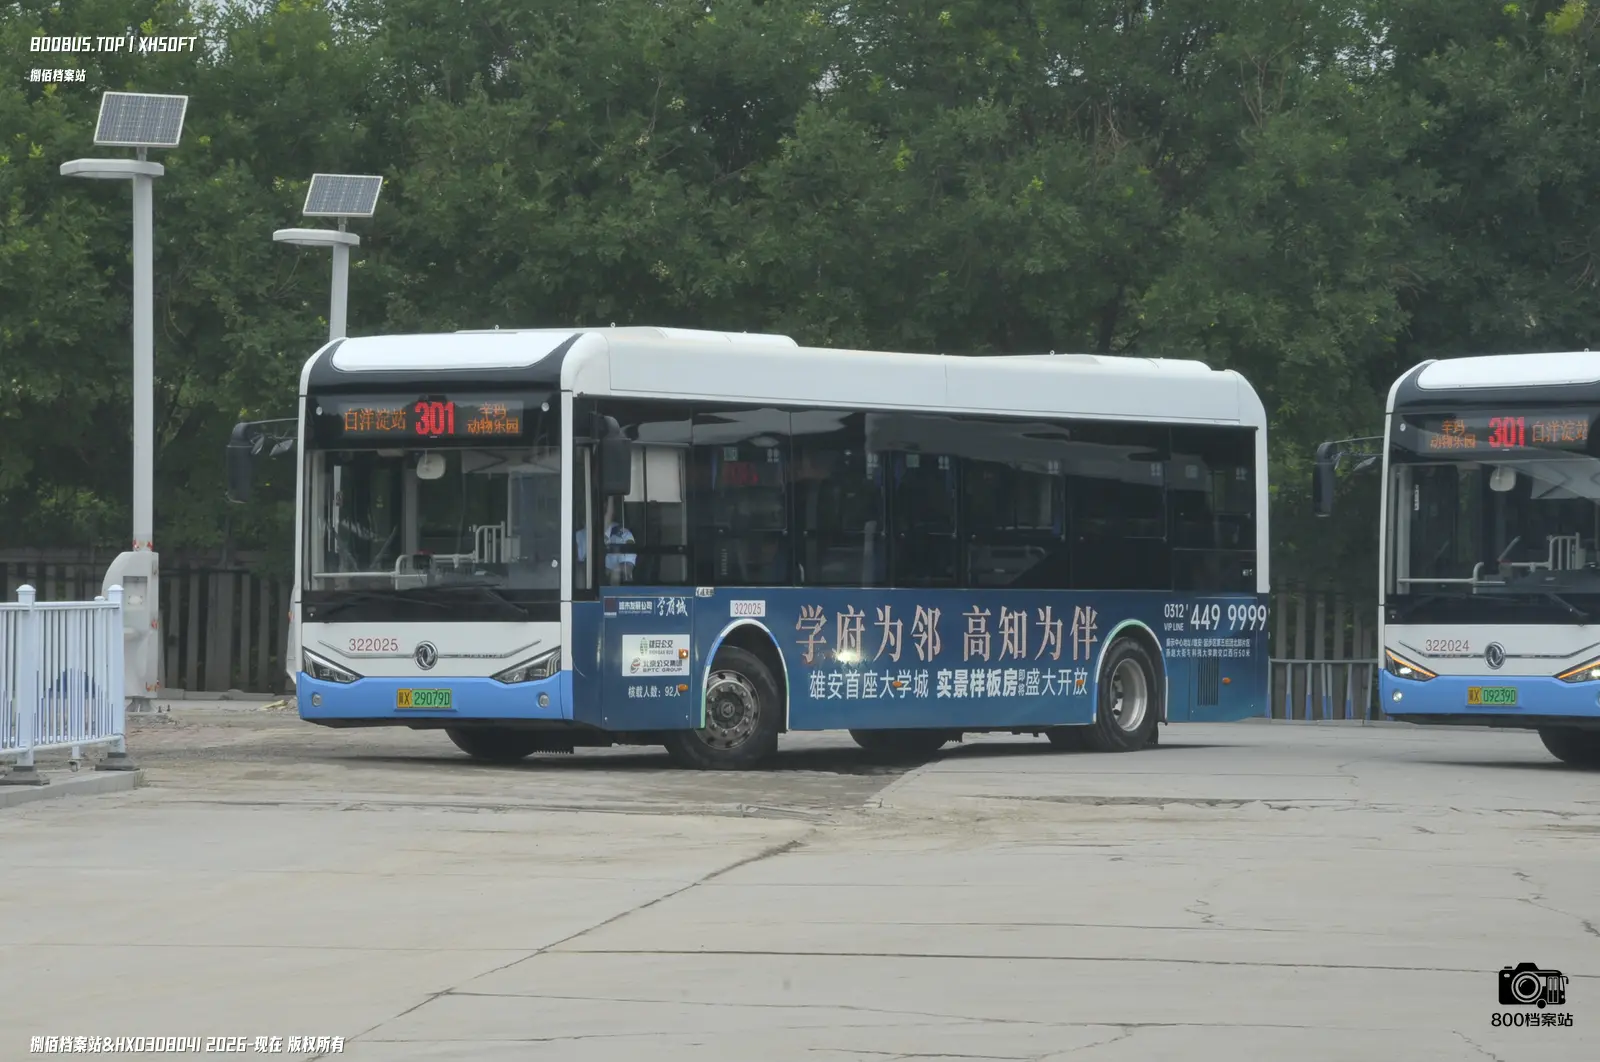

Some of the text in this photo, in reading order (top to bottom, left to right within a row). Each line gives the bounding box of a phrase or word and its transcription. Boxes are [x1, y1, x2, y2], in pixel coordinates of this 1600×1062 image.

[344, 401, 456, 435] 白洋淀站 301
[467, 418, 519, 434] 动物乐园
[1488, 416, 1525, 448] 301
[733, 602, 762, 615] 322025
[1164, 603, 1267, 631] 0312 449 9999
[348, 638, 399, 652] 322025
[795, 604, 1099, 663] 学府为邻 高知为伴
[1425, 640, 1470, 652] 322024
[809, 669, 929, 700] 雄安首座大学城
